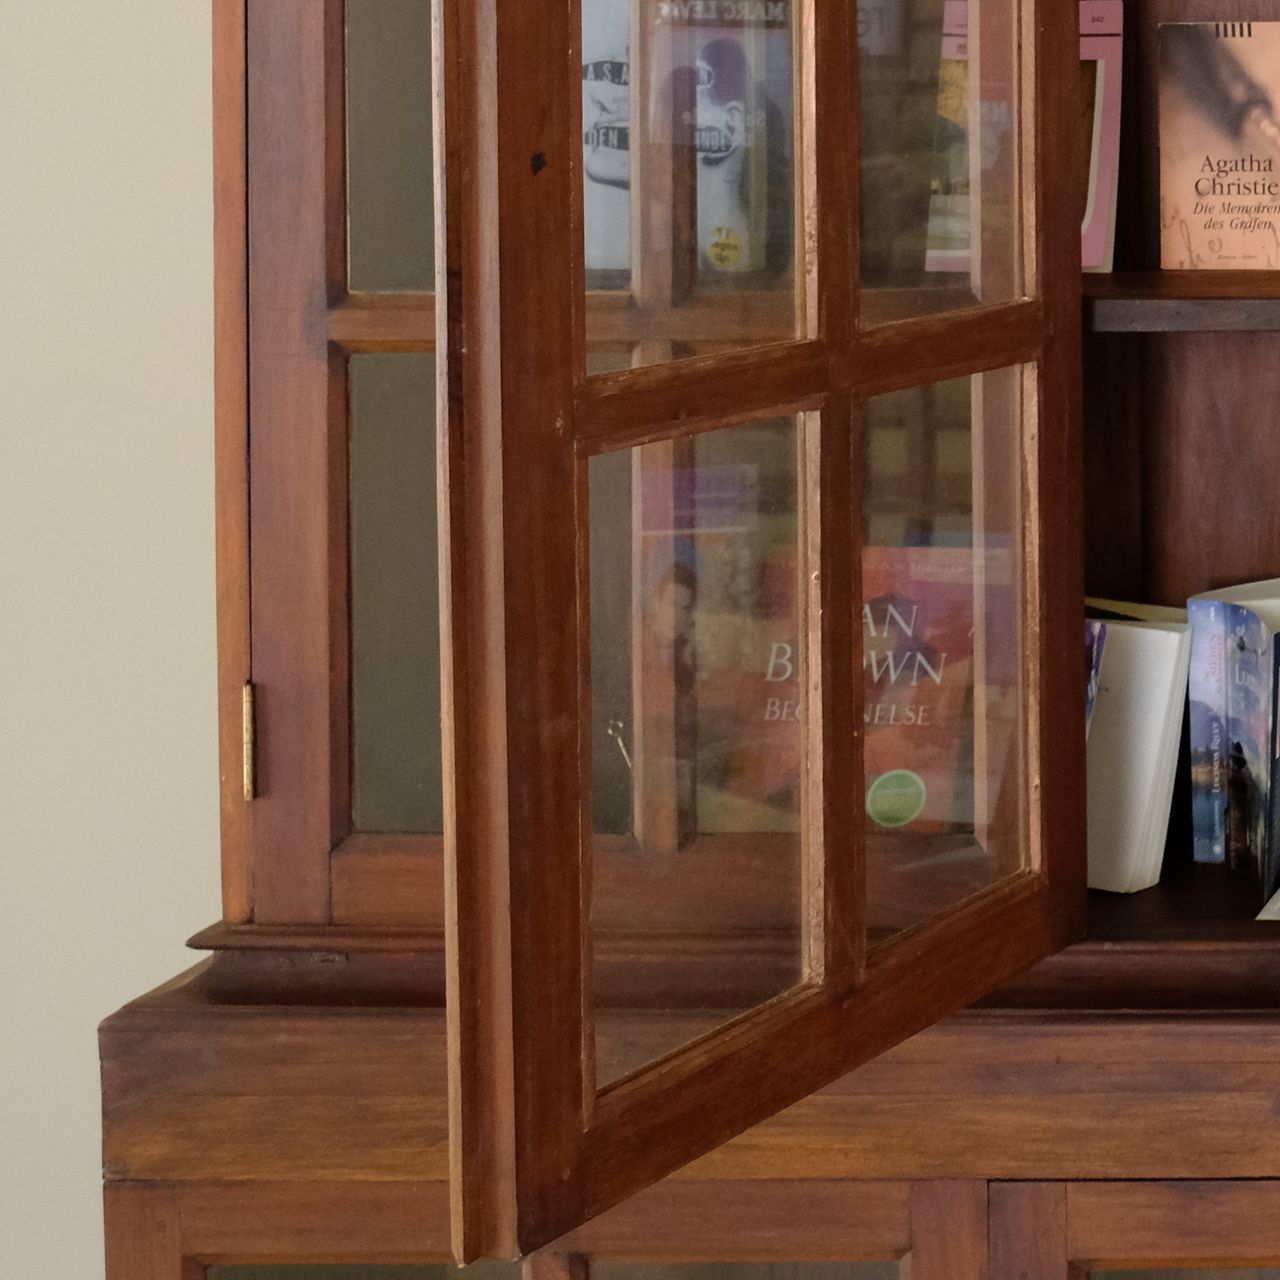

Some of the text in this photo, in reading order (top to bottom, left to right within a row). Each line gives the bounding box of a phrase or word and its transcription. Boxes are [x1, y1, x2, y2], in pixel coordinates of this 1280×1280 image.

[1200, 154, 1274, 178] Agatha
[1194, 176, 1280, 197] Christie
[1193, 200, 1216, 216] Die
[1203, 216, 1274, 232] des Grafen
